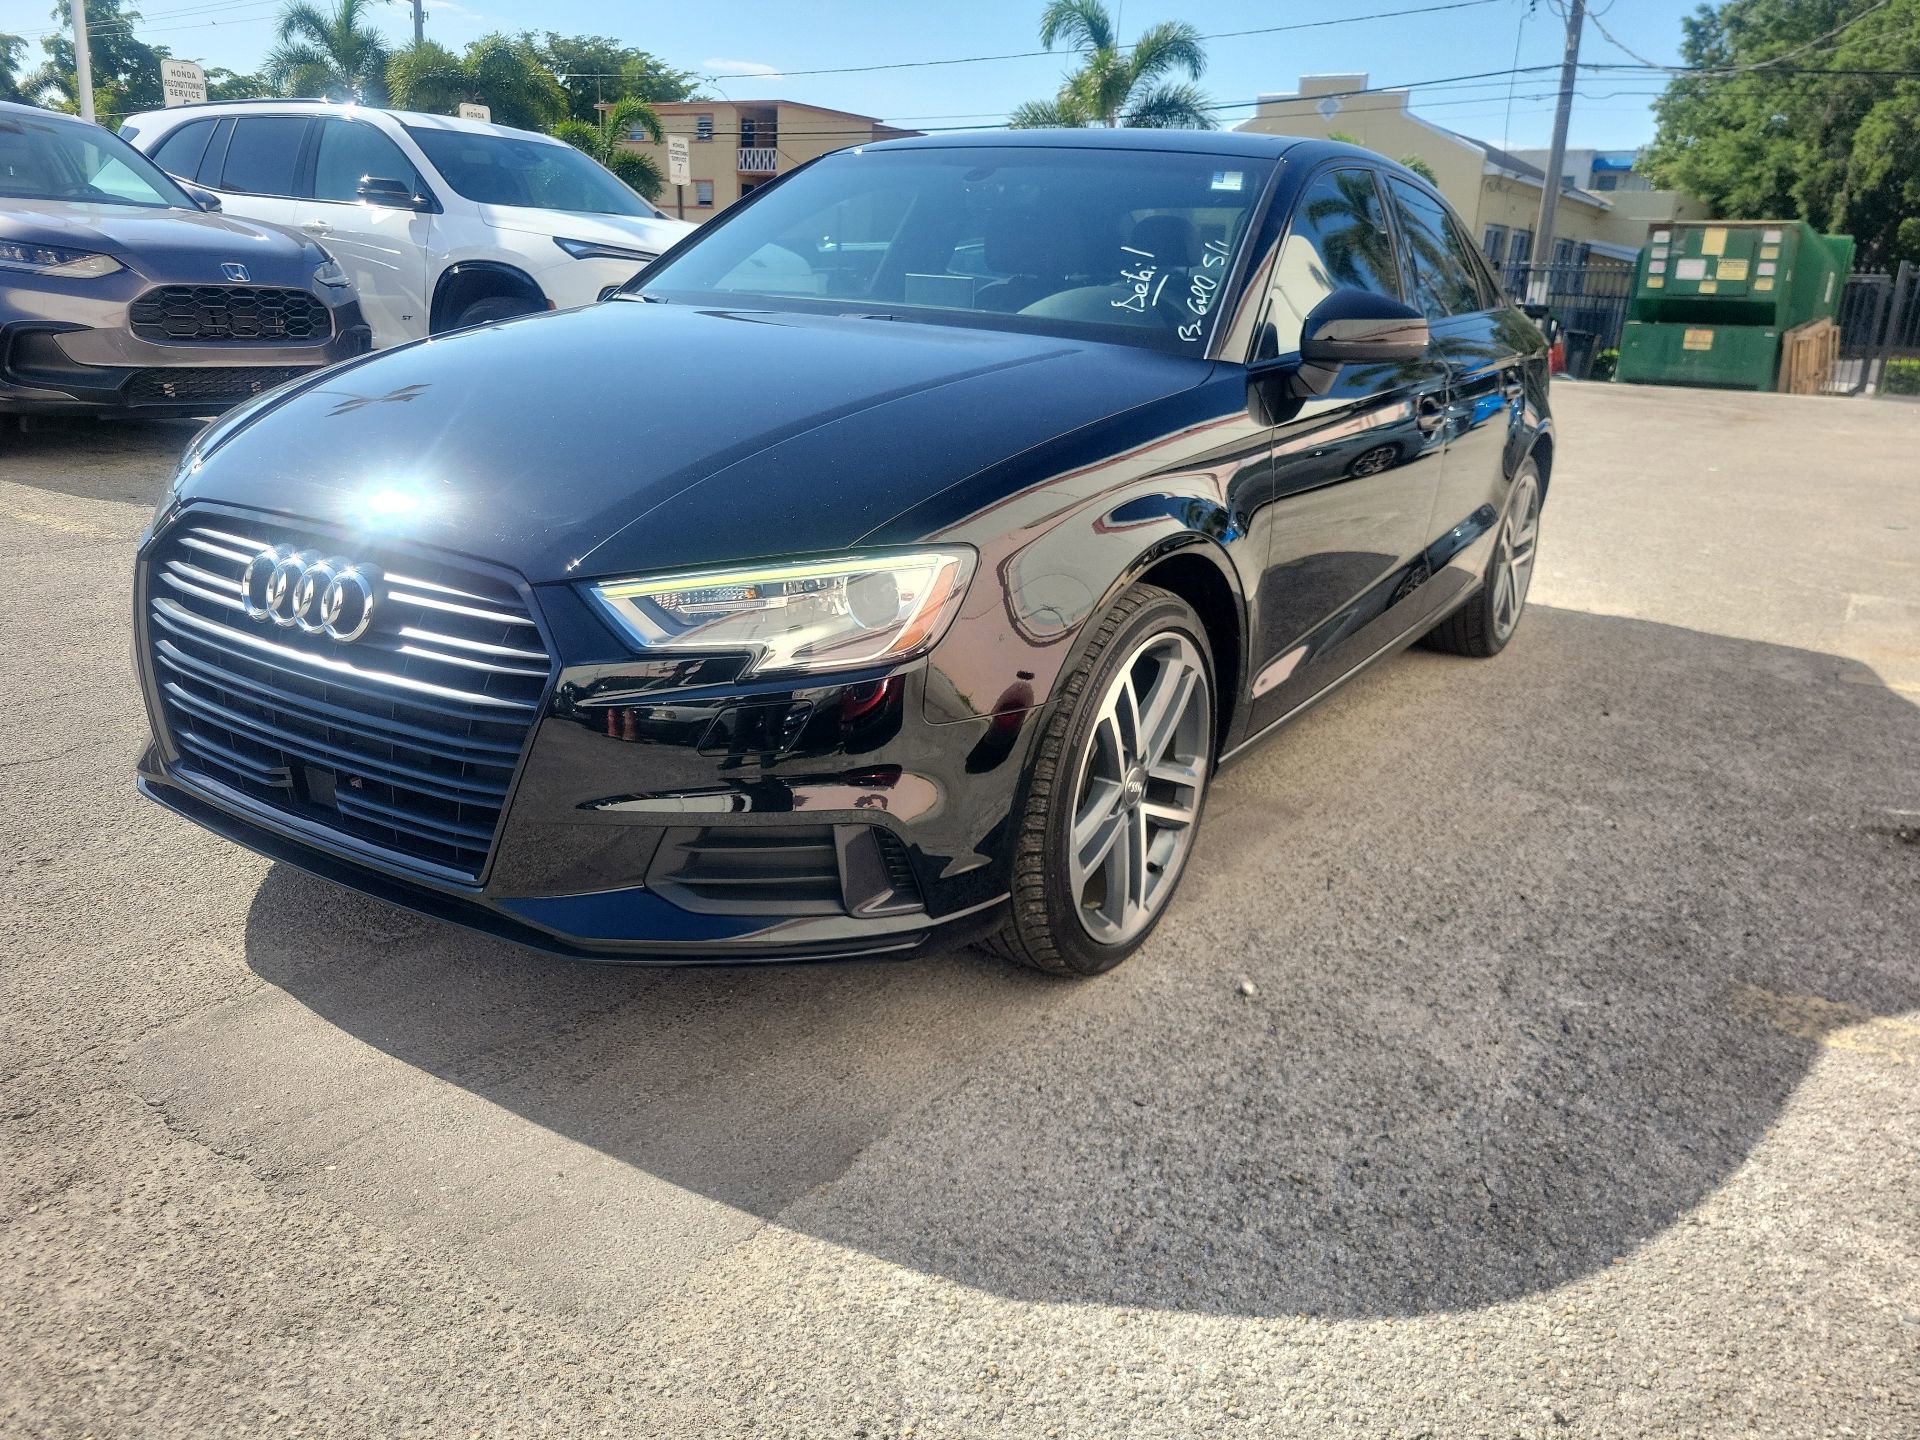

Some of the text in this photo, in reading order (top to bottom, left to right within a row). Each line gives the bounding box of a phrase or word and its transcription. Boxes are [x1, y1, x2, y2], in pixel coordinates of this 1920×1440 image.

[171, 70, 196, 79] HONDA
[169, 89, 200, 99] SERVICE
[677, 163, 682, 173] 7
